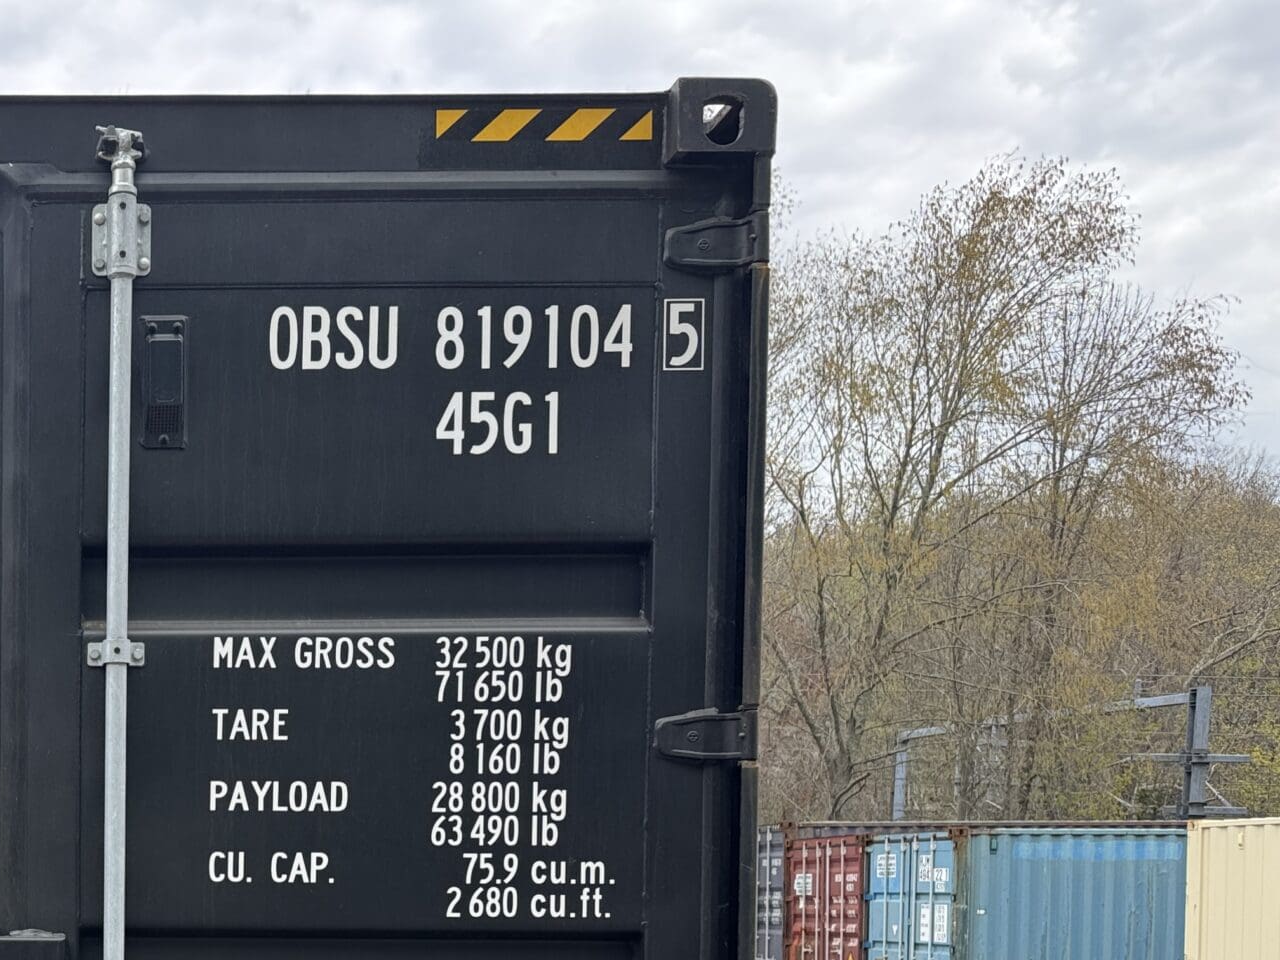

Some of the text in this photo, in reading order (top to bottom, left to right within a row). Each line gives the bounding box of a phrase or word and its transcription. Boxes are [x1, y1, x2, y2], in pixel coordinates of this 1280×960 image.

[269, 303, 699, 370] OBSU 819104 5
[436, 391, 559, 455] 45G1
[213, 636, 396, 669] MAX GROSS
[536, 636, 573, 677] kg
[535, 671, 563, 703] lb
[212, 708, 289, 741] TARE
[533, 709, 570, 749] kg
[532, 743, 561, 775] lb
[209, 780, 349, 812] PAYLOAD
[531, 781, 568, 821] kg
[531, 815, 559, 847] lb
[208, 851, 336, 884] CU. CAP.
[462, 853, 617, 886] 75.9 cu.m.
[530, 887, 612, 919] cu.ft.
